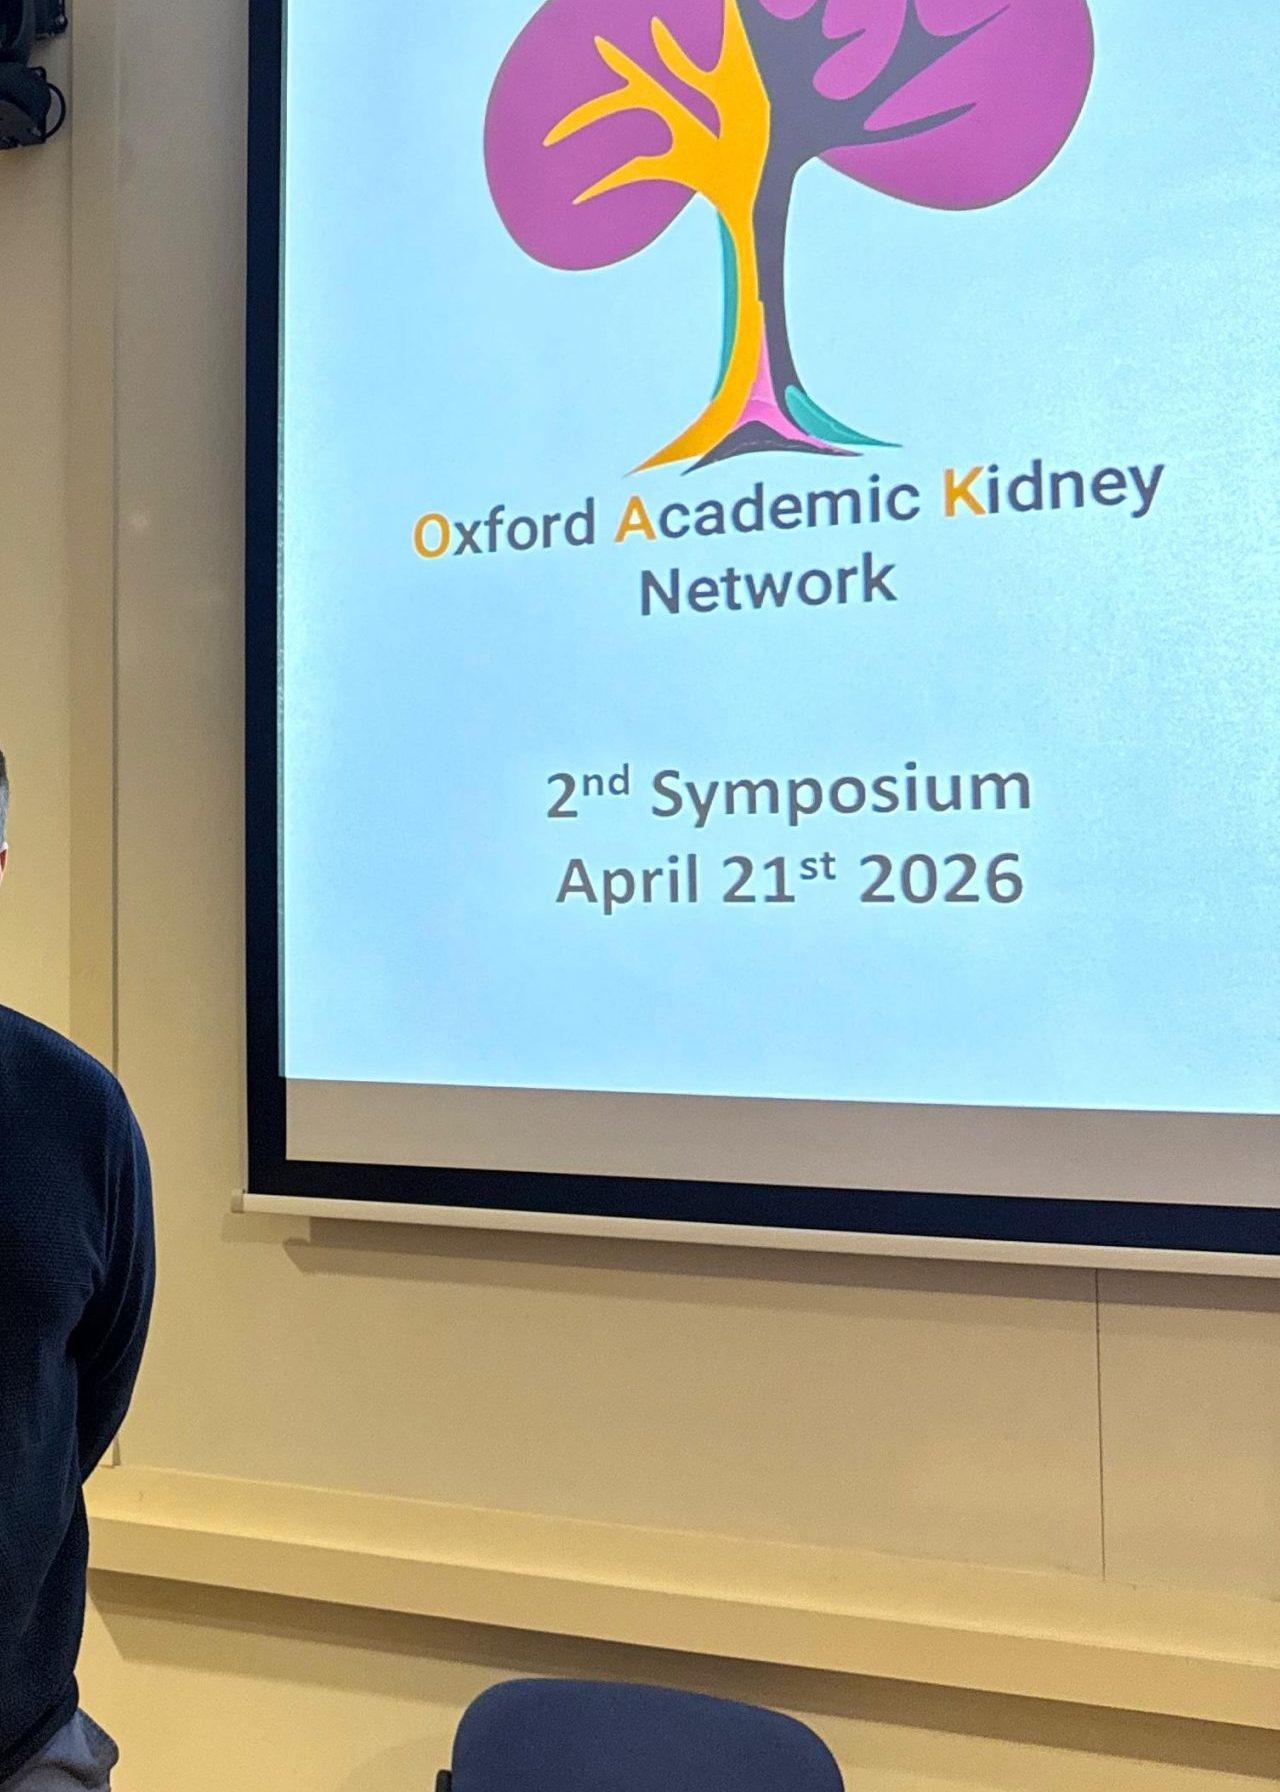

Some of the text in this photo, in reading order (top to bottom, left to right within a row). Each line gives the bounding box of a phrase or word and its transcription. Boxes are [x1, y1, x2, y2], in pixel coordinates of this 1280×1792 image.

[413, 458, 1165, 559] Oxford Academic Kidney
[641, 552, 898, 617] Network
[547, 761, 1031, 829] 2nd Symposium
[556, 851, 1024, 916] April 21st 2026
